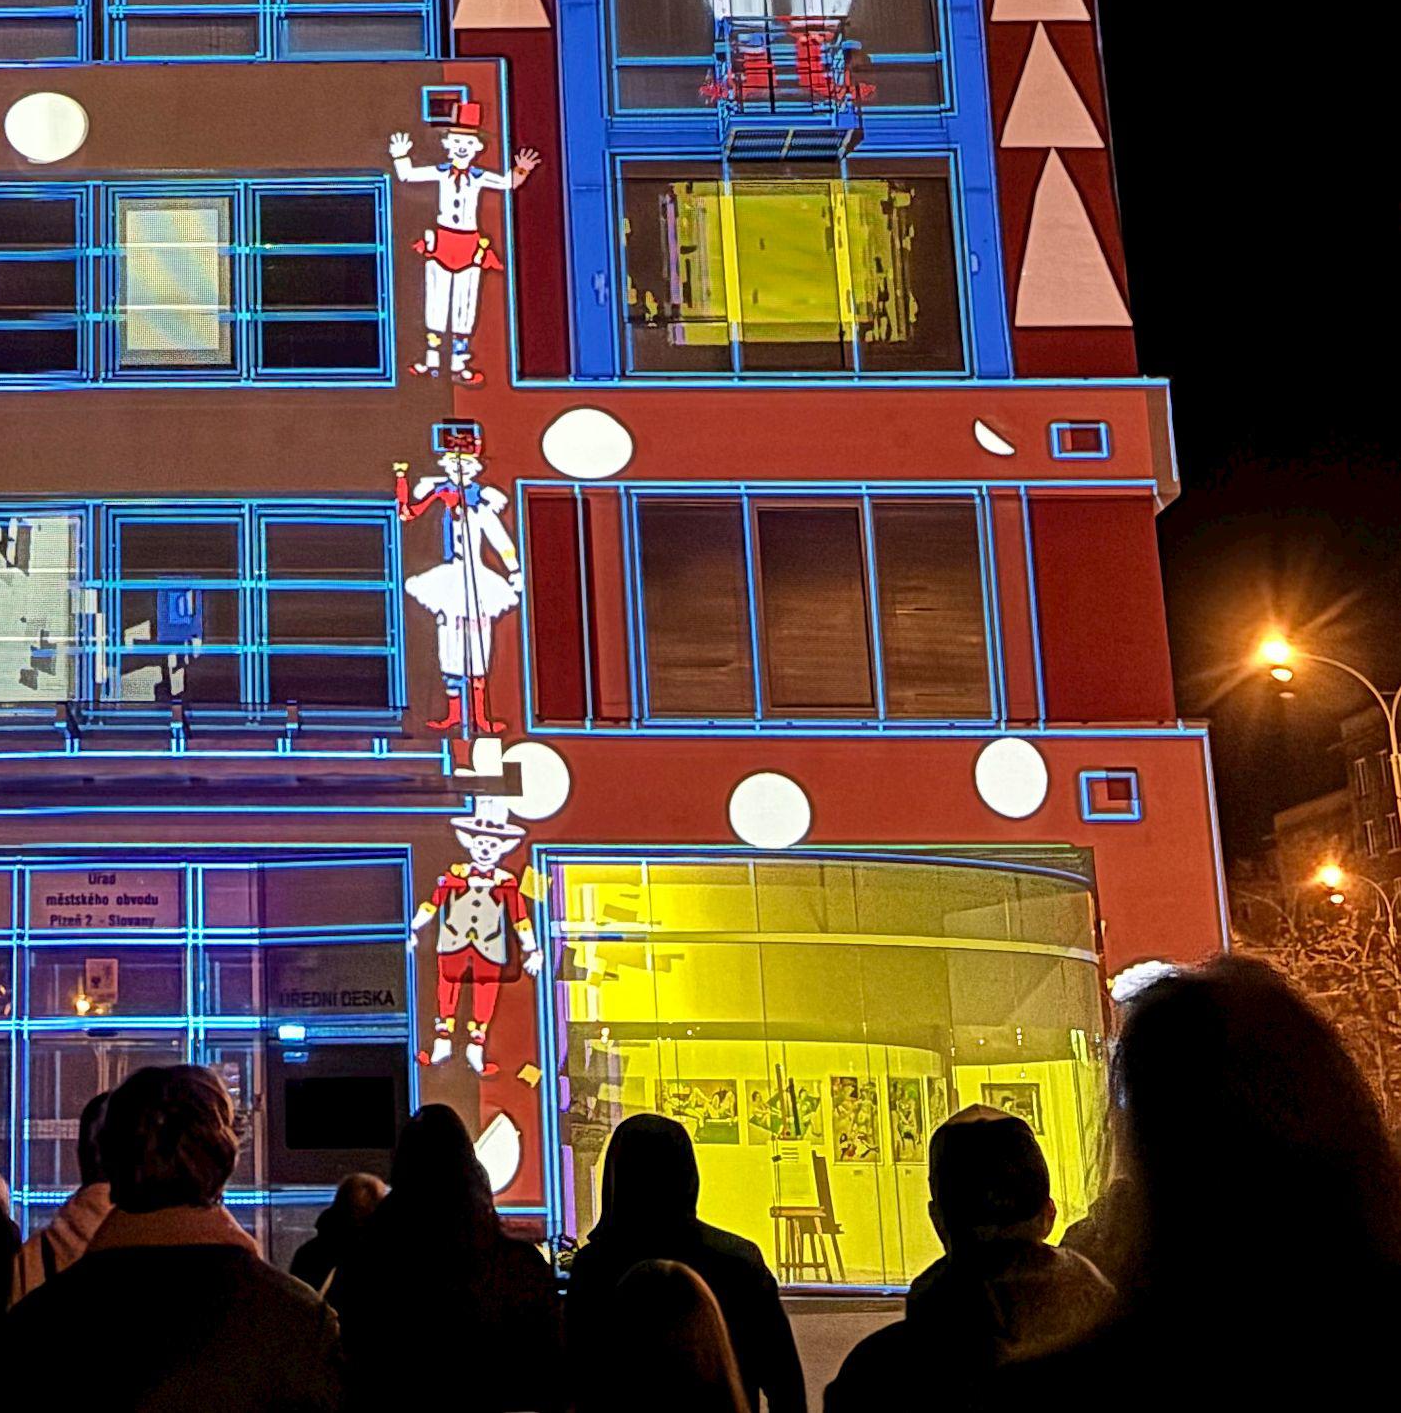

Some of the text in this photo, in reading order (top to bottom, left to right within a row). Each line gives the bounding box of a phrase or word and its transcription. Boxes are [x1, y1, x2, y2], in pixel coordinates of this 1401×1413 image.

[46, 892, 158, 905] městského obvodu
[50, 914, 81, 926] Plzeň
[85, 914, 93, 926] 2
[108, 914, 155, 928] Slovany
[340, 989, 396, 1006] DESKA
